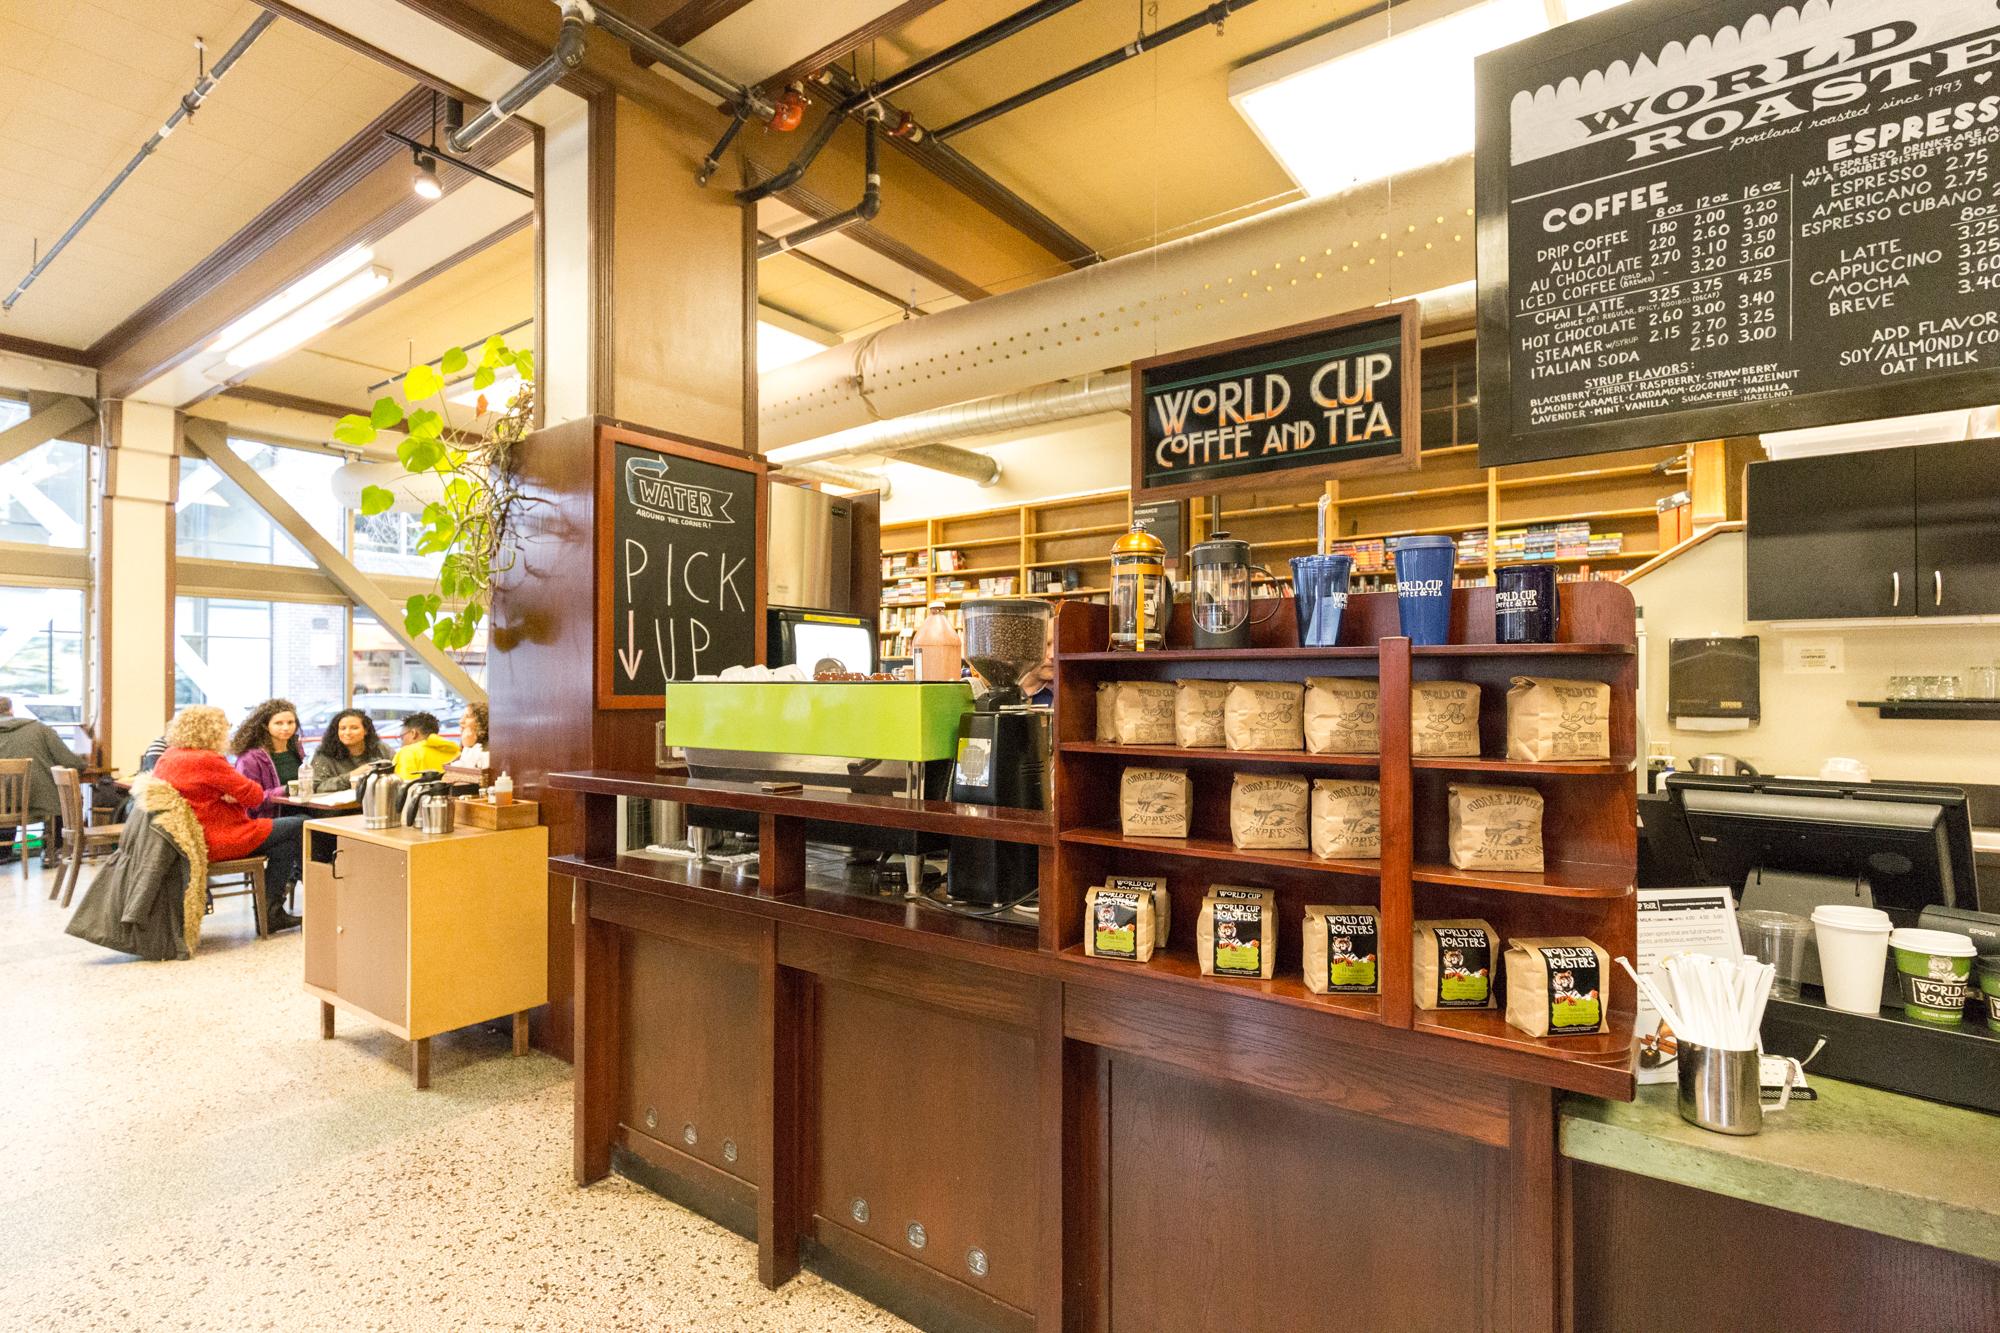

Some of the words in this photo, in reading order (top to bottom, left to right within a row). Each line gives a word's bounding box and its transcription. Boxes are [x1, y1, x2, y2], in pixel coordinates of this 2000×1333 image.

[1575, 20, 1917, 138] WORLD
[1729, 122, 1802, 151] portland
[1808, 104, 1871, 129] roasted
[1878, 93, 1923, 112] since
[1928, 79, 1962, 98] 1993
[1805, 165, 1829, 179] ALL
[1833, 150, 1896, 172] ESPRESSO
[1903, 136, 1952, 154] DRINKS
[1954, 129, 1981, 142] ARE
[1823, 174, 1834, 183] A
[1839, 162, 1887, 177] DOUBLE
[1891, 142, 1963, 166] RISTRETTO
[1830, 164, 1927, 197] ESPRESSO
[1945, 148, 1988, 171] 2.75
[1543, 181, 1668, 232] COFFEE
[1656, 207, 1665, 218] 8
[1696, 196, 1710, 209] 12
[1744, 184, 1760, 200] 16
[1812, 181, 1932, 218] AMERICANO
[1945, 167, 1988, 189] 2.75
[1537, 244, 1569, 262] DRIP
[1573, 230, 1629, 253] COFFEE
[1652, 221, 1678, 236] 1.80
[1694, 209, 1725, 226] 2.00
[1742, 199, 1777, 215] 2.20
[1801, 207, 1891, 237] ESPRESSO
[1898, 188, 1982, 215] CUBANO
[1960, 204, 1998, 221] 8oz
[1550, 258, 1572, 274] AU
[1577, 249, 1612, 267] LAIT
[1649, 235, 1676, 251] 2.20
[1693, 224, 1730, 241] 2.60
[1743, 212, 1778, 230] 3.00
[1840, 238, 1902, 263] LATTE
[1958, 218, 1999, 240] 3.25
[1520, 292, 1556, 311] ICED
[1562, 278, 1617, 301] COFFEE
[1690, 255, 1726, 274] 3.20
[1739, 245, 1775, 264] 3.60
[1529, 278, 1550, 293] AU
[1556, 256, 1642, 287] CHOCOLATE
[1650, 249, 1680, 267] 2.70
[1691, 239, 1727, 258] 3.10
[1741, 228, 1776, 247] 3.50
[1809, 249, 1942, 285] CAPPUCCINO
[1958, 237, 2000, 258] 3.25
[1828, 273, 1910, 299] MOCHA
[1958, 254, 2000, 276] 3.60
[1535, 307, 1570, 325] CHAI
[1578, 296, 1625, 317] LATTE
[1648, 285, 1680, 303] 3.25
[1691, 277, 1723, 295] 3.75
[1737, 267, 1773, 285] 4.25
[1829, 292, 1894, 316] BREVE
[1521, 334, 1550, 351] HOT
[1555, 317, 1637, 343] CHOCOLATE
[1649, 308, 1683, 326] 2.60
[1691, 300, 1726, 317] 3.00
[1738, 290, 1775, 309] 3.40
[1535, 340, 1603, 364] STEAMER
[1649, 325, 1680, 343] 2.15
[1691, 317, 1727, 335] 2.70
[1738, 308, 1775, 327] 3.25
[1554, 318, 1584, 330] CHOICE
[1871, 326, 1909, 343] ADD
[1918, 311, 1999, 335] FLAVOR
[1530, 357, 1592, 380] ITALIAN
[1597, 350, 1640, 368] SODA
[1690, 333, 1729, 351] 2.50
[1738, 325, 1777, 343] 3.00
[1880, 357, 1918, 376] OAT
[1926, 350, 1979, 369] MILK
[1530, 389, 1591, 407] BLACKBERRY
[1596, 383, 1633, 396] CHERRY
[1640, 374, 1701, 391] RASPBERRY
[1706, 362, 1778, 380] STRAWBERRY
[1530, 402, 1574, 416] ALMOND
[1578, 395, 1625, 408] CARAMEL
[1629, 387, 1685, 401] CARDAMOM
[1689, 378, 1737, 393] COCONUT
[1743, 369, 1800, 385] HAZELNUT
[1584, 373, 1623, 389] SYRUP
[1628, 361, 1694, 382] FLAVORS:
[1154, 374, 1291, 437] WORLD
[1310, 353, 1392, 408] CUP
[1531, 409, 1587, 425] LAVENDER
[1594, 405, 1620, 416] MINT
[1625, 398, 1669, 411] VANILLA
[1744, 382, 1789, 394] VANILLA
[1155, 423, 1252, 468] COFFEE
[1261, 420, 1316, 454] AND
[1323, 402, 1393, 445] TEA
[639, 479, 713, 517] WATER
[636, 508, 665, 521] AROUND
[667, 516, 680, 525] THE
[625, 538, 746, 612] PICK
[1425, 580, 1443, 591] CUP
[1520, 589, 1537, 600] CUP
[655, 617, 710, 681] UP
[1241, 779, 1273, 795] PUDDLE
[1273, 780, 1305, 795] JUMPER
[1328, 785, 1360, 801] PUDDLE
[1467, 793, 1504, 812] PUDDLE
[1128, 813, 1185, 826] ESPRESSO
[1242, 825, 1305, 839] ESPRESSO
[1098, 891, 1124, 899] WORLD
[1215, 903, 1245, 912] WORLD
[1246, 905, 1260, 913] CUP
[1219, 890, 1246, 899] WORLD
[1217, 910, 1259, 922] ROASTERS
[1327, 915, 1358, 925] WORLD
[1358, 915, 1374, 925] CUP
[1331, 924, 1375, 935] ROASTERS
[1435, 928, 1468, 938] WORLD
[1469, 929, 1485, 938] CUP
[1968, 927, 1996, 938] EPSON
[1440, 937, 1487, 948] ROASTERS
[1540, 947, 1577, 958] WORLD
[1575, 947, 1593, 957] CUP
[1548, 957, 1596, 969] ROASTERS
[1916, 981, 1962, 997] WORLD
